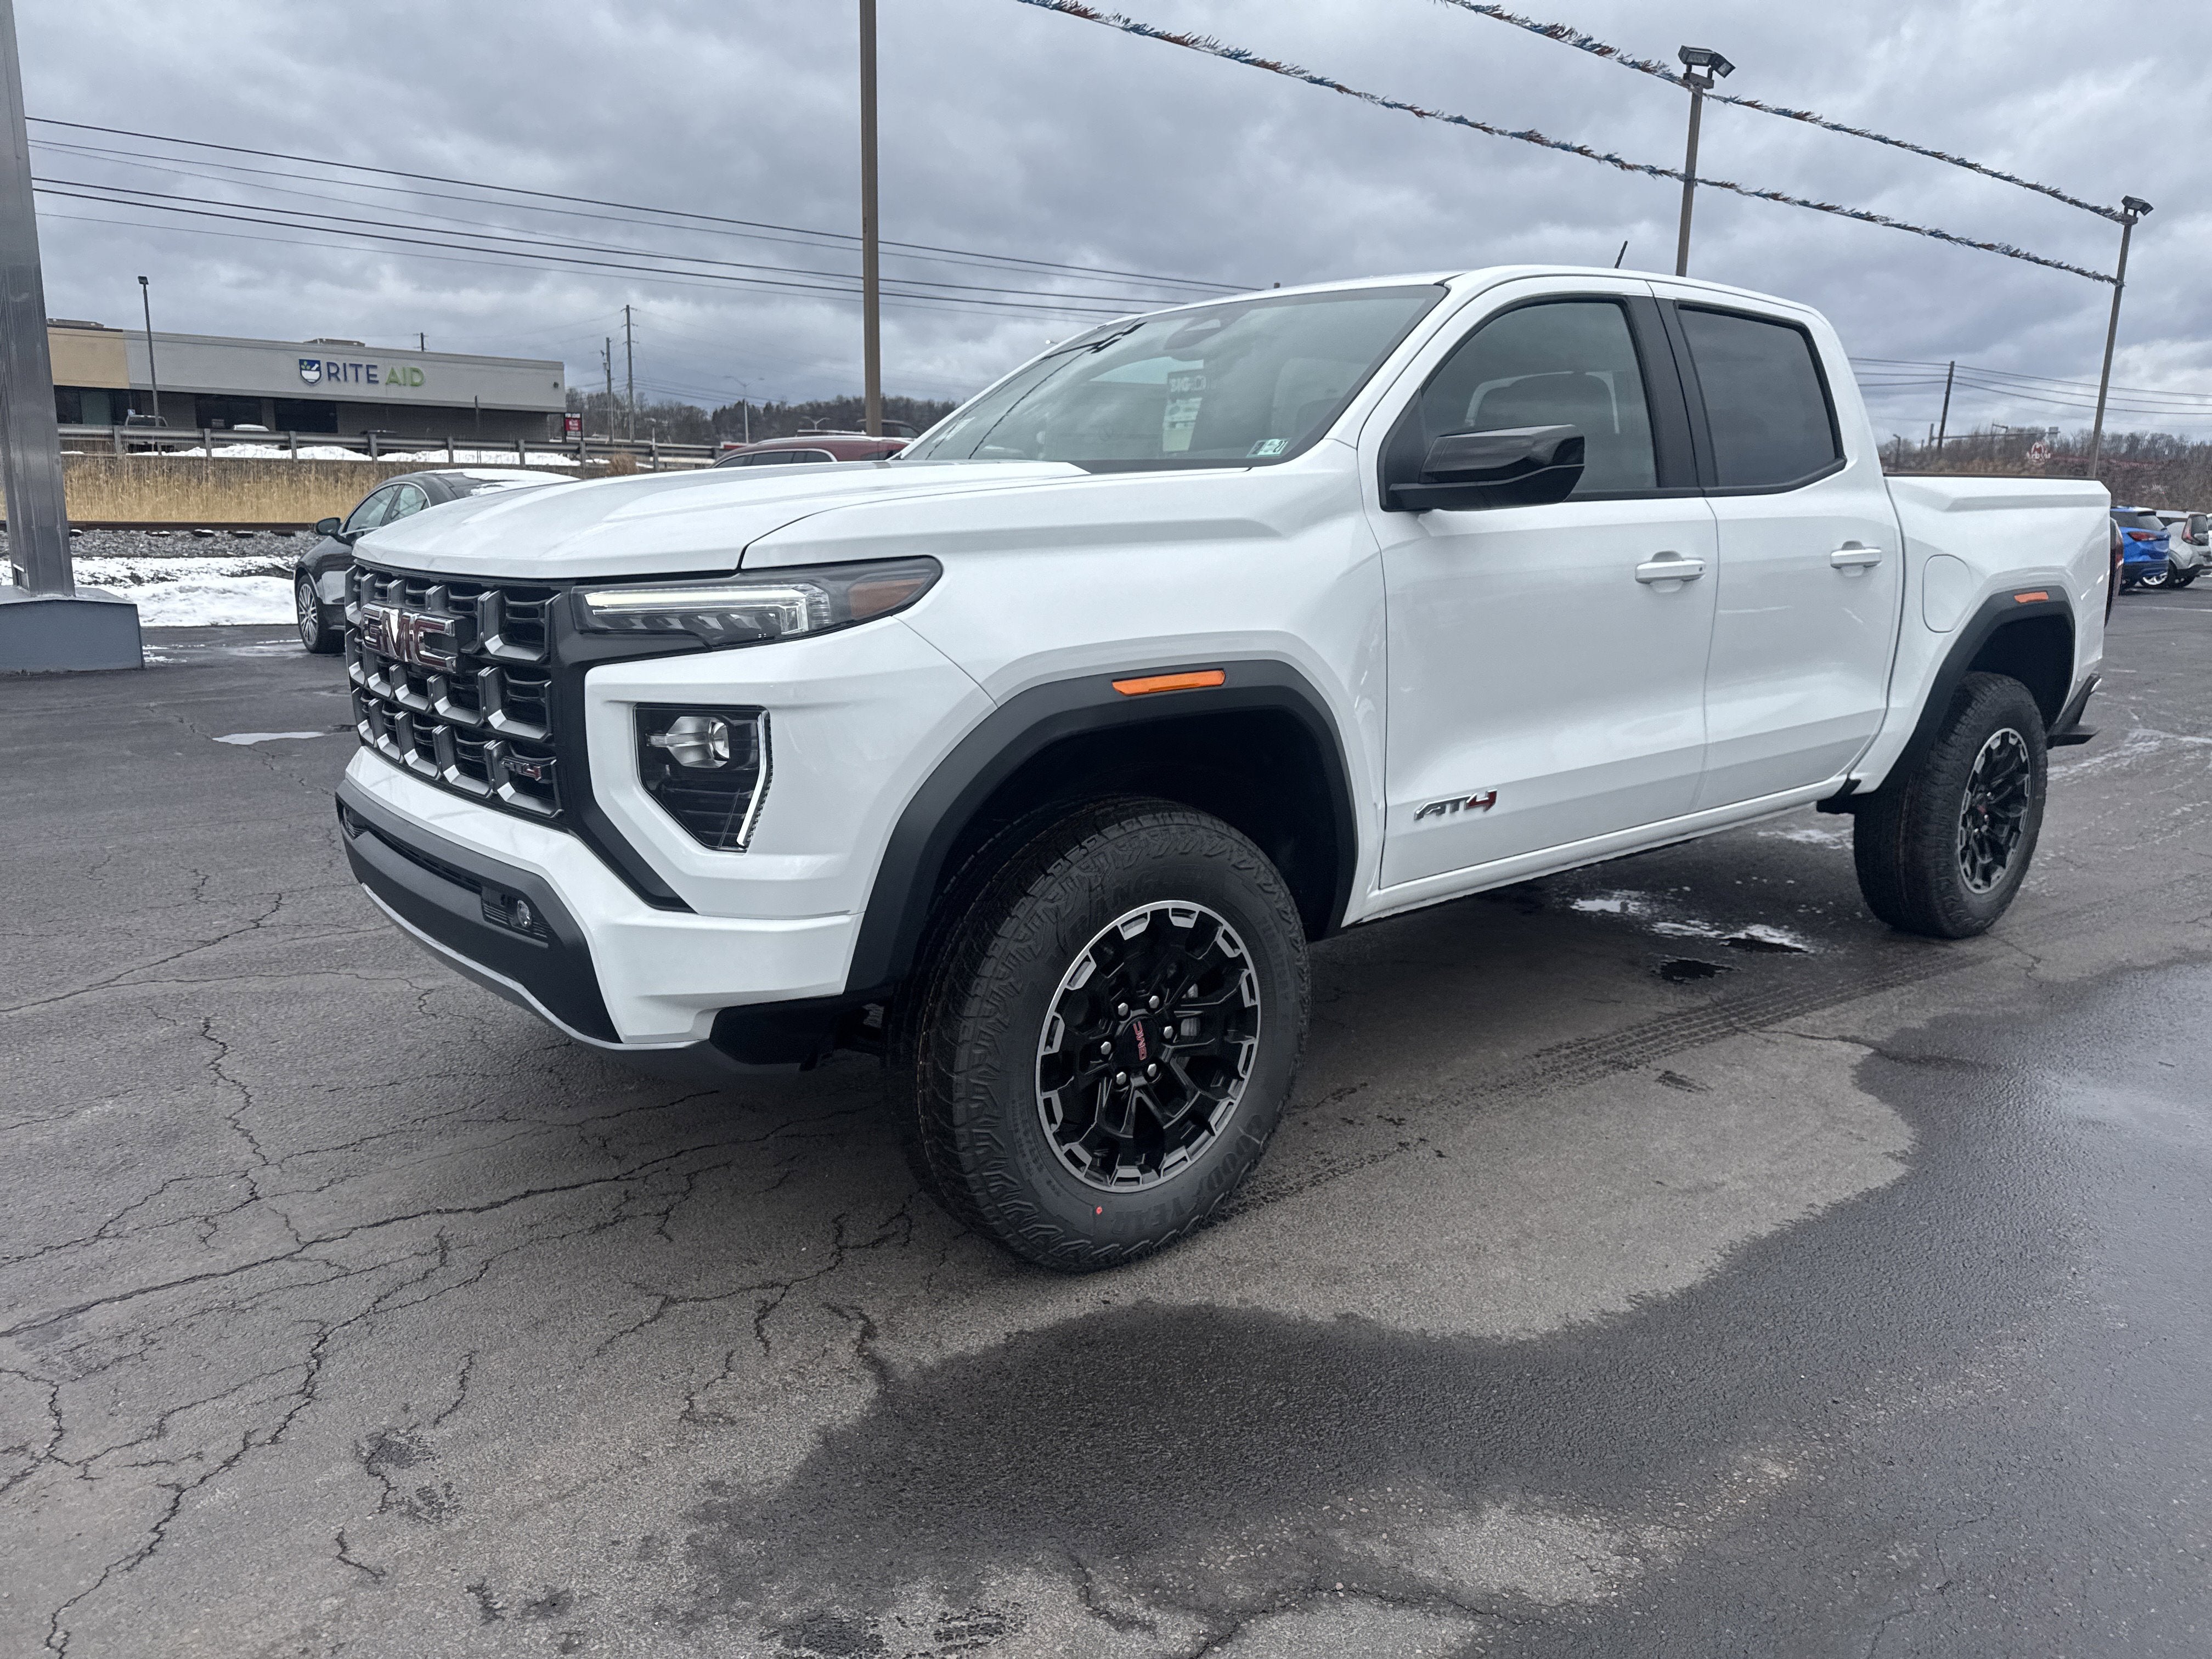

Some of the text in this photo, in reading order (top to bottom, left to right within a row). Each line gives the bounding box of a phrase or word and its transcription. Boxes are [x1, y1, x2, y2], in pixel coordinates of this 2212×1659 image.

[326, 362, 425, 386] RITE AID
[362, 603, 456, 673] GMC
[1414, 789, 1498, 821] AT4
[1133, 1021, 1147, 1060] GMC
